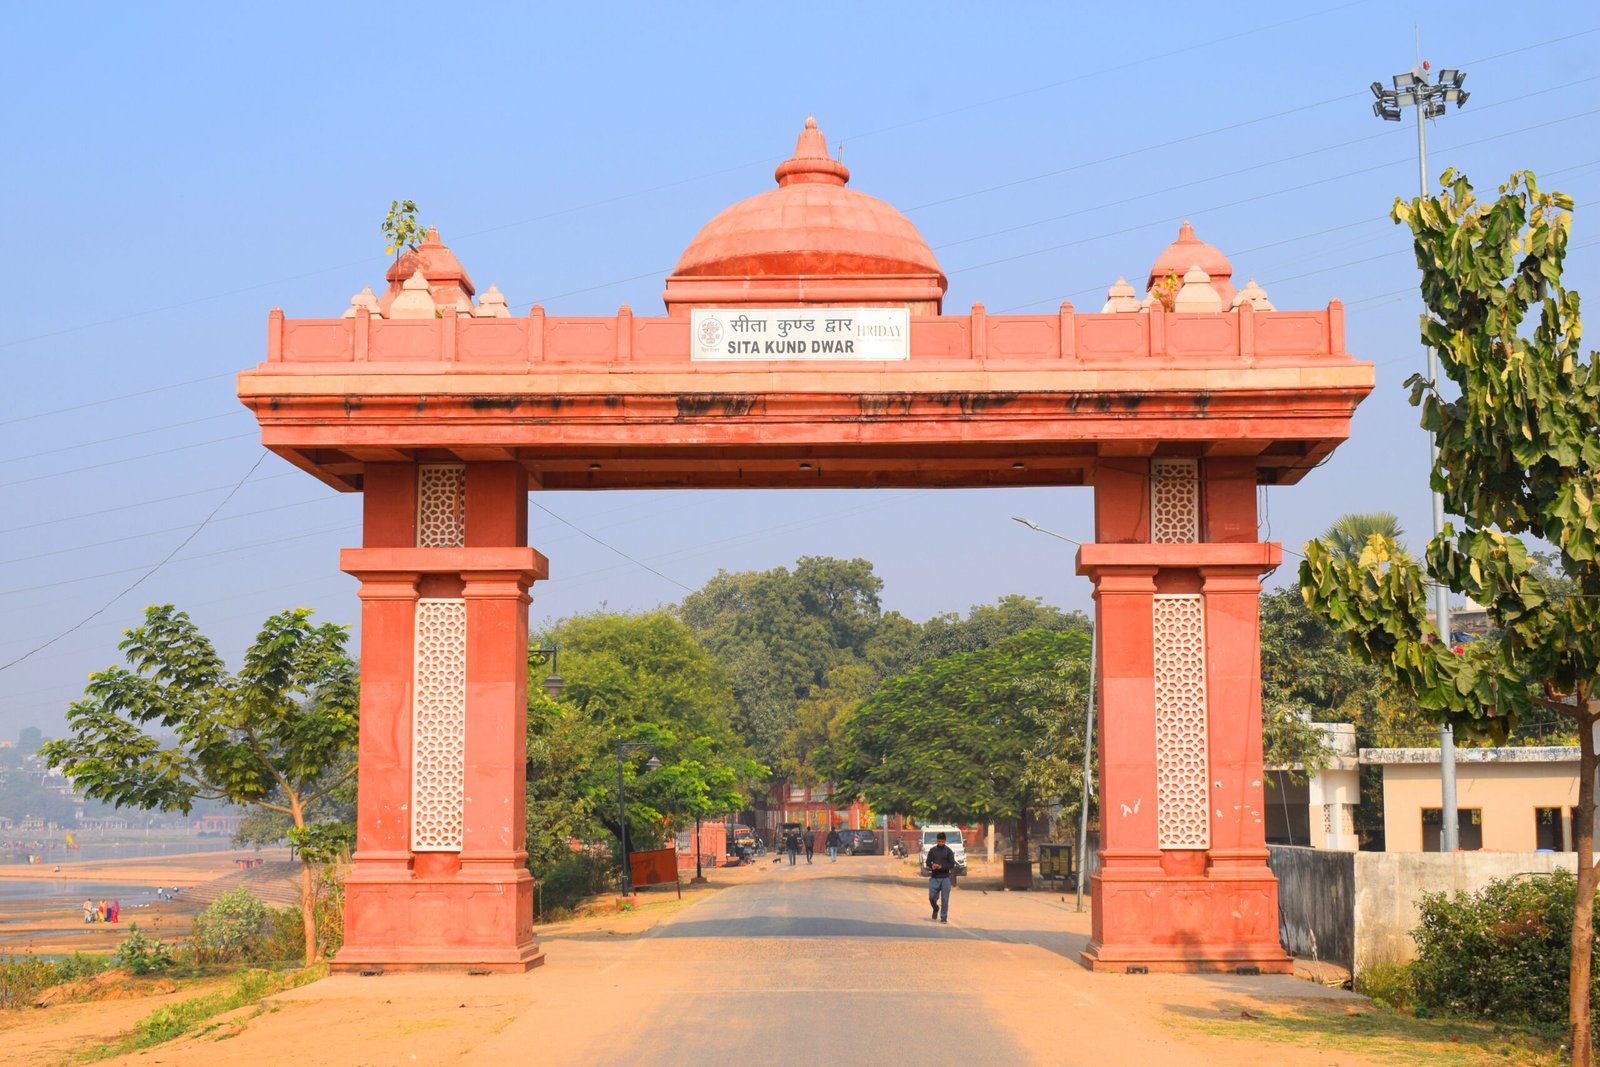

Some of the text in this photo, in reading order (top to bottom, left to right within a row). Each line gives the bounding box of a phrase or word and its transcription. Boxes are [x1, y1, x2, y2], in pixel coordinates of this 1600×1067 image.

[730, 314, 853, 337] सीता कुण्ड द्वार
[857, 325, 902, 337] HRIDAY
[728, 340, 760, 354] SITA
[765, 340, 806, 354] KUND
[811, 340, 854, 354] DWAR
